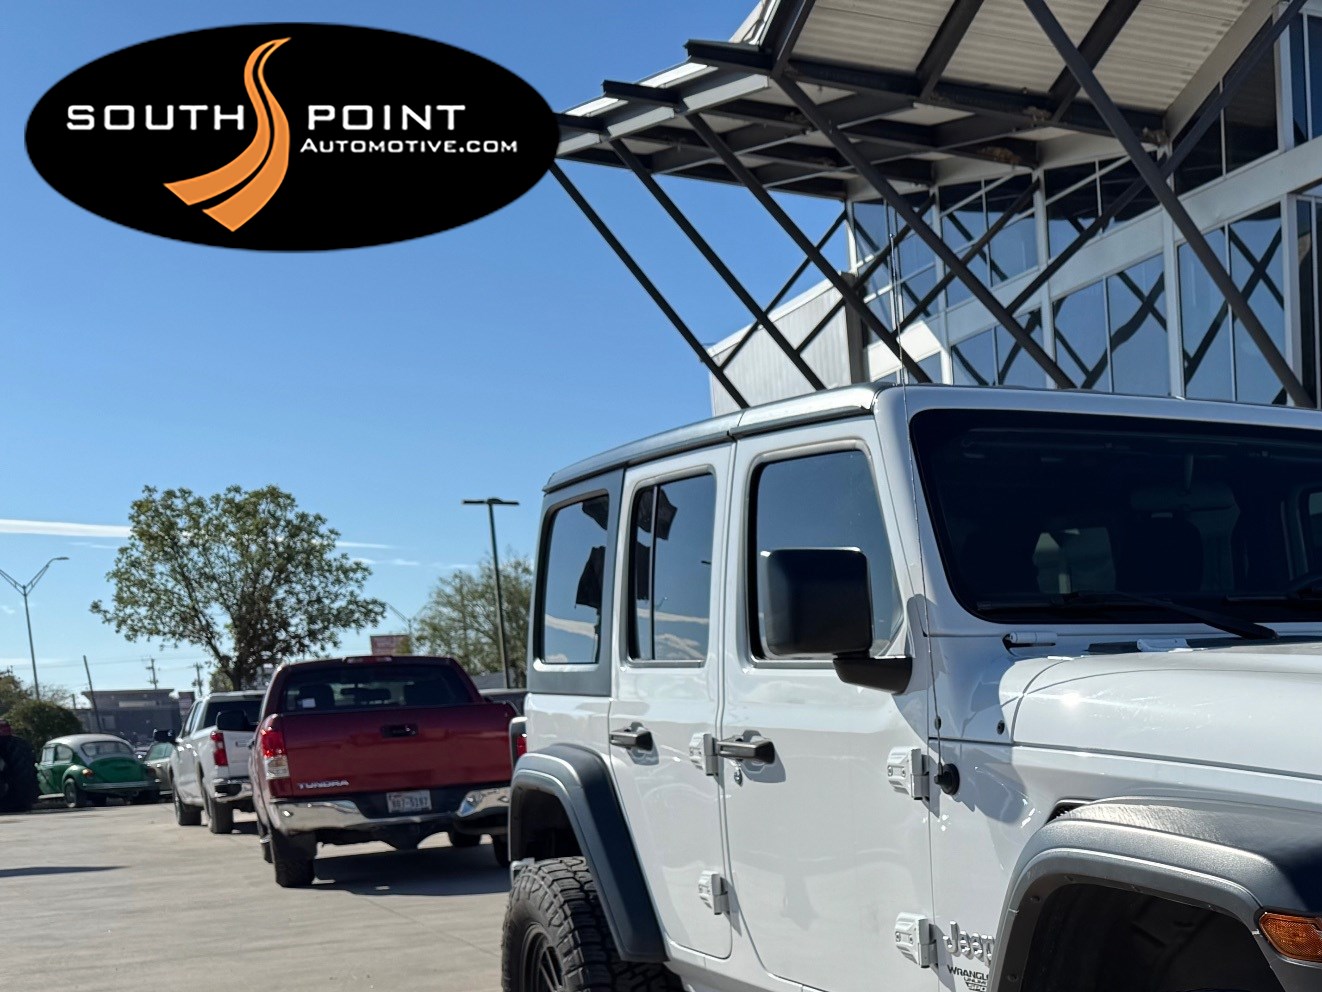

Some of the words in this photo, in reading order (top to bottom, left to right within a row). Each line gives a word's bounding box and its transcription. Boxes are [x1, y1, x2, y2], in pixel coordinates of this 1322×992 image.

[298, 779, 350, 790] TUNDRA
[942, 919, 995, 963] Jeep
[946, 964, 989, 981] WRANGL
